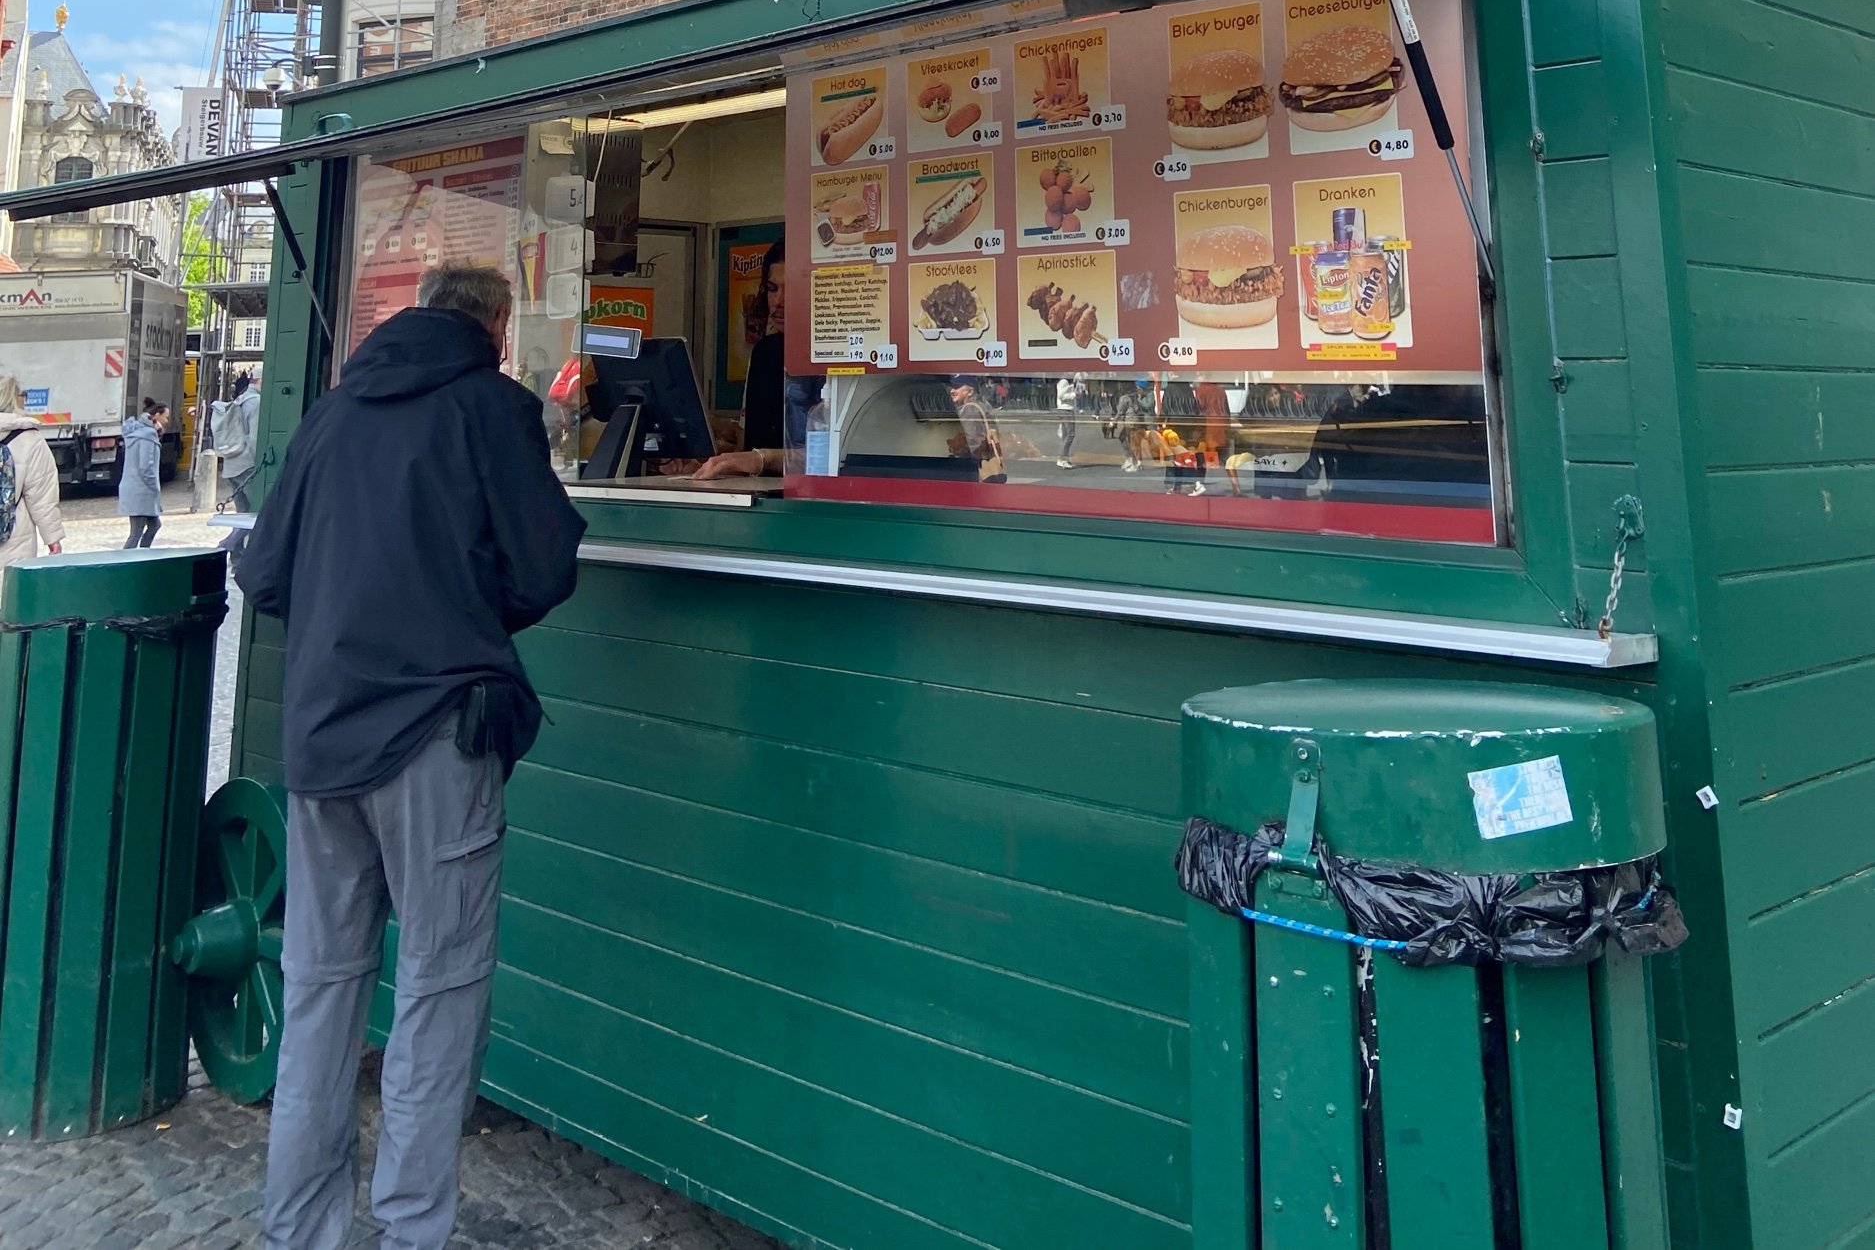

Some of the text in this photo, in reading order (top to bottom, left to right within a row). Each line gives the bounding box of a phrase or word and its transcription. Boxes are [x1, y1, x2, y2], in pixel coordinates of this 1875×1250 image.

[1172, 13, 1260, 38] Bicky burger
[1020, 36, 1103, 59] Chickenfingers
[921, 54, 979, 76] Vleeskroket
[830, 77, 867, 91] Hot dog
[982, 77, 998, 87] 5,00
[206, 99, 220, 156] DEVAN
[1385, 139, 1409, 152] 4,80
[1031, 145, 1097, 163] Bitterballen
[922, 158, 979, 175] Braadworst
[1168, 161, 1187, 173] 4,50
[816, 172, 883, 188] Hamburger Menu
[1319, 186, 1376, 202] Dranken
[1178, 195, 1268, 213] Chickenburger
[1107, 228, 1125, 239] 3,00
[731, 252, 766, 274] Kipfin
[926, 264, 978, 277] Stoofvlees
[1322, 271, 1350, 285] Lipton
[1355, 266, 1382, 317] Fanta
[583, 299, 647, 323] pkorn
[1111, 344, 1130, 357] 4,50
[1172, 345, 1193, 357] 4,80
